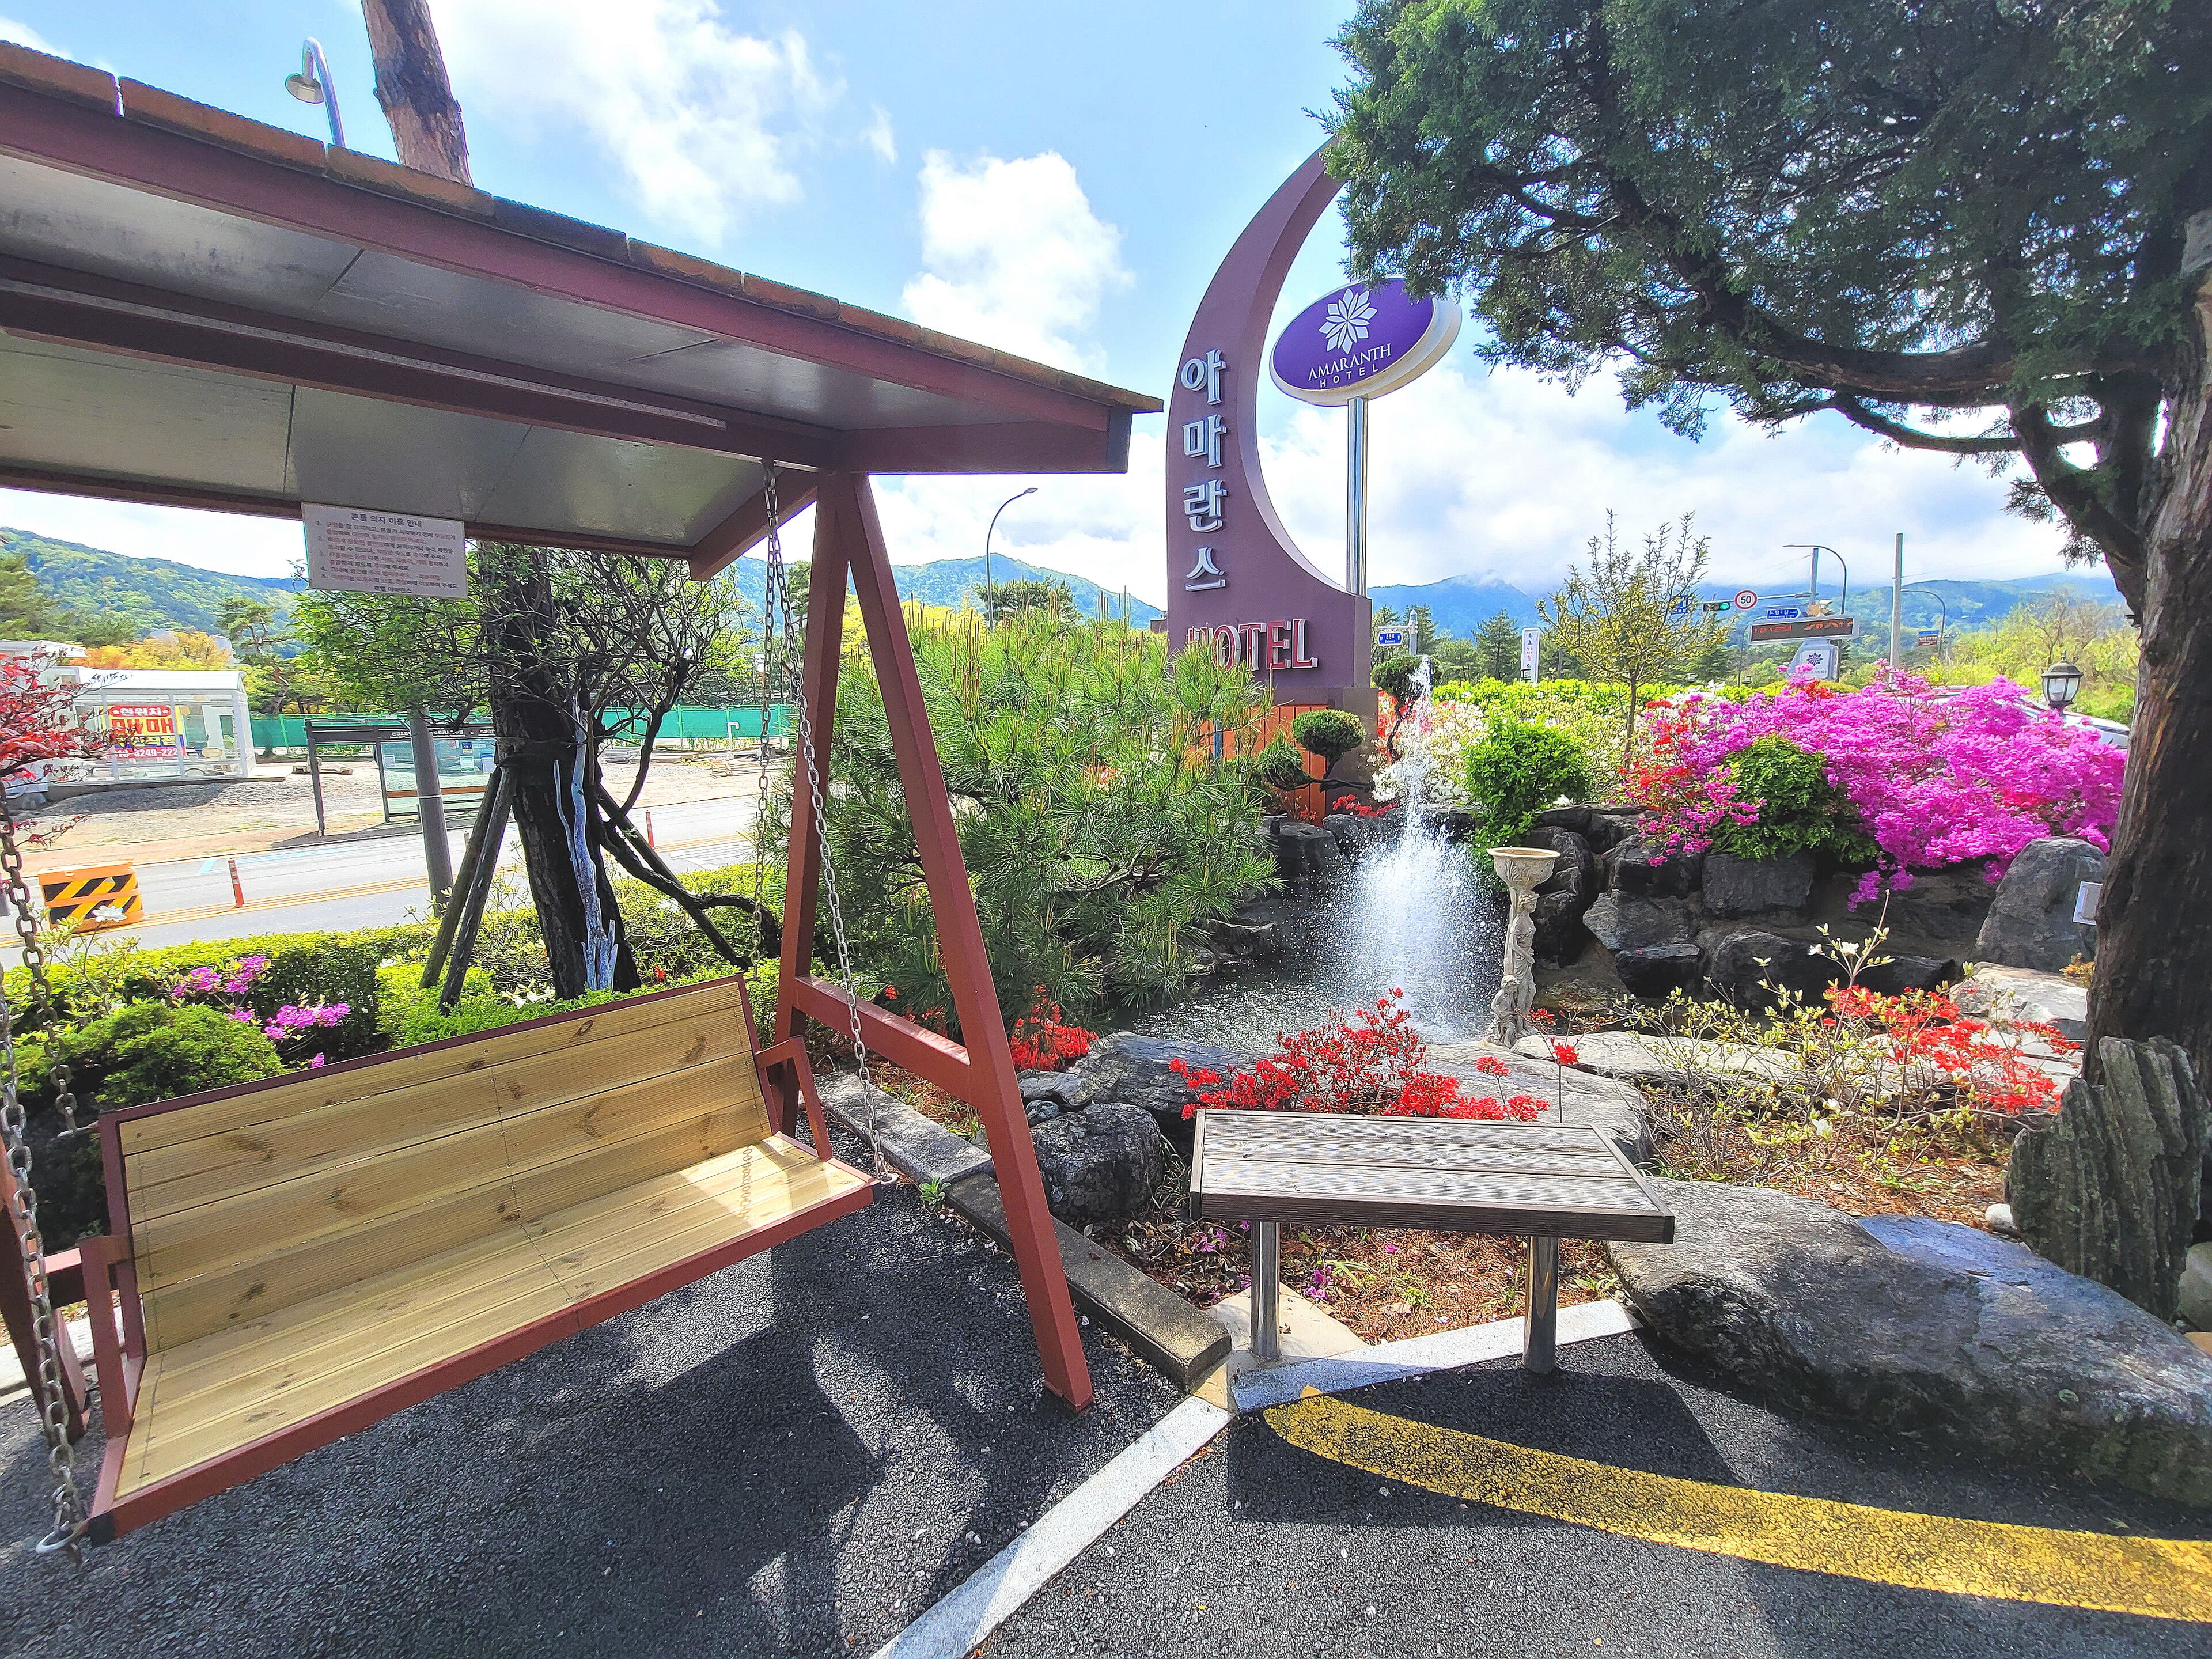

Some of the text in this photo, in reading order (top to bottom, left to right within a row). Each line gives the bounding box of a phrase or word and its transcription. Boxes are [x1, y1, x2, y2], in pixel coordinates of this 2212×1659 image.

[1308, 343, 1391, 382] AMARANTH
[1320, 363, 1379, 388] HOTEL
[1181, 349, 1227, 592] 아마란스
[351, 513, 422, 528] 흔들 의자 이용 안내
[1740, 595, 1752, 605] 50
